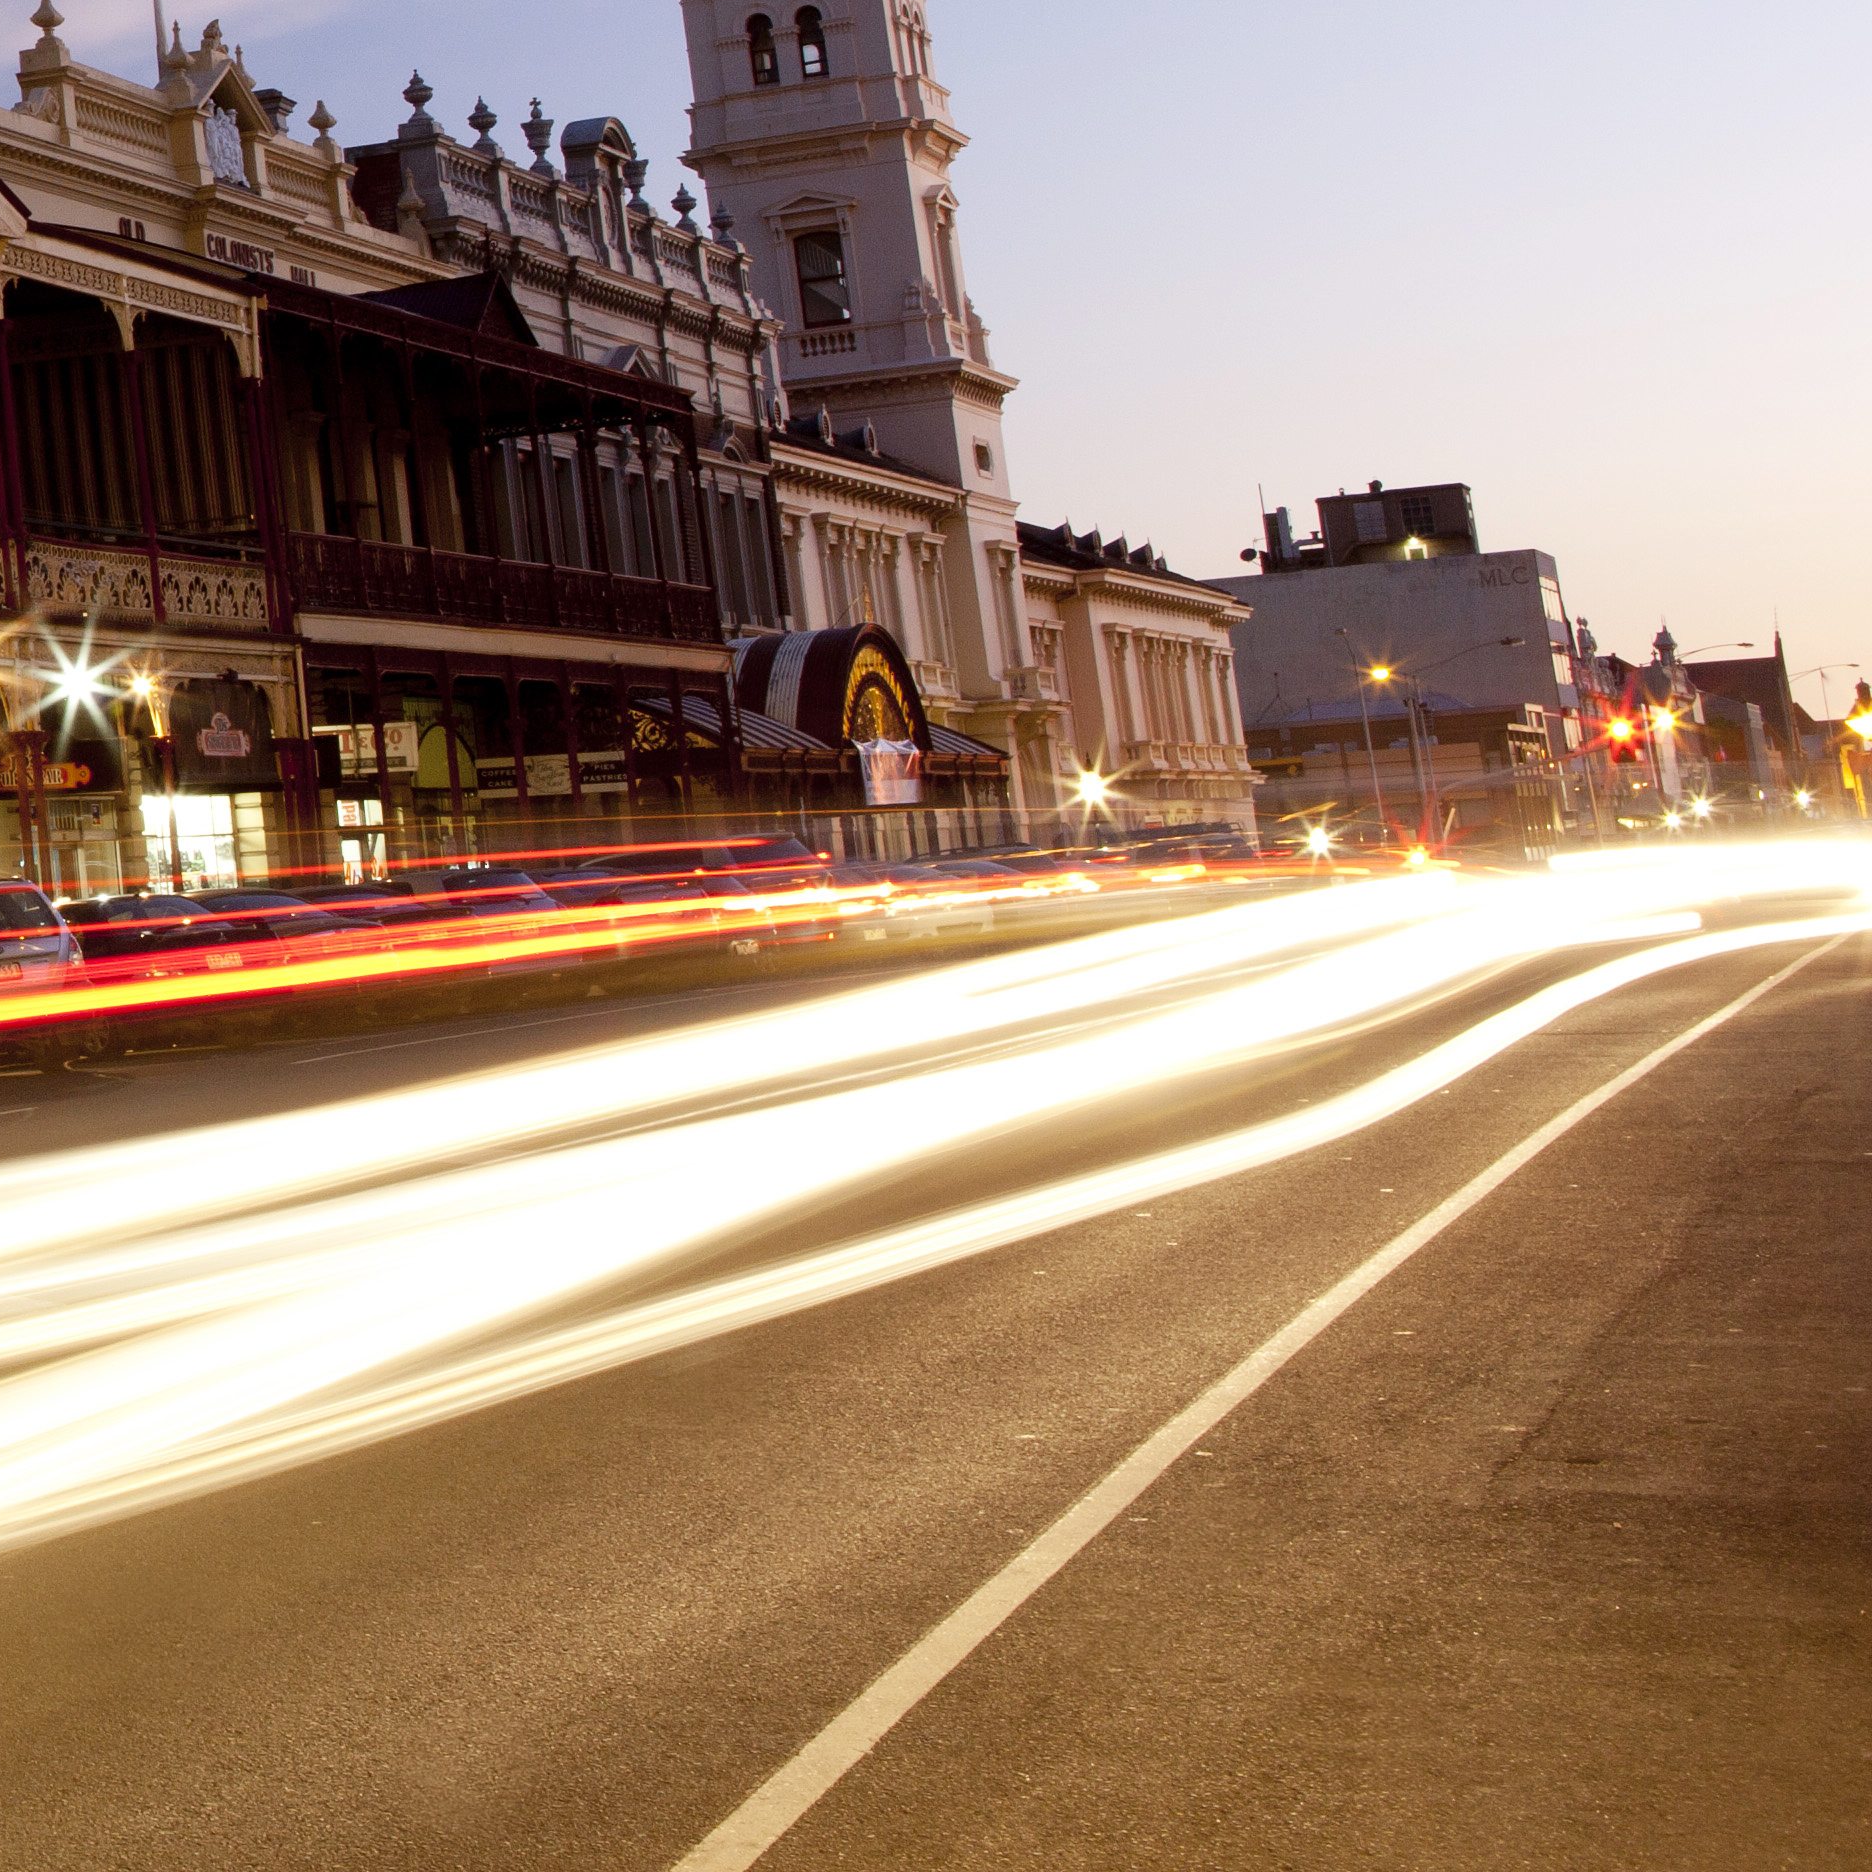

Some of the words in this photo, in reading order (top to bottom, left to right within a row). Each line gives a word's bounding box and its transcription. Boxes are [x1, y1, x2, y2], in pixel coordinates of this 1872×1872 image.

[119, 216, 146, 241] OLD
[1479, 566, 1530, 588] MLC
[481, 769, 517, 777] COFFEE
[583, 773, 628, 781] PASTRIES
